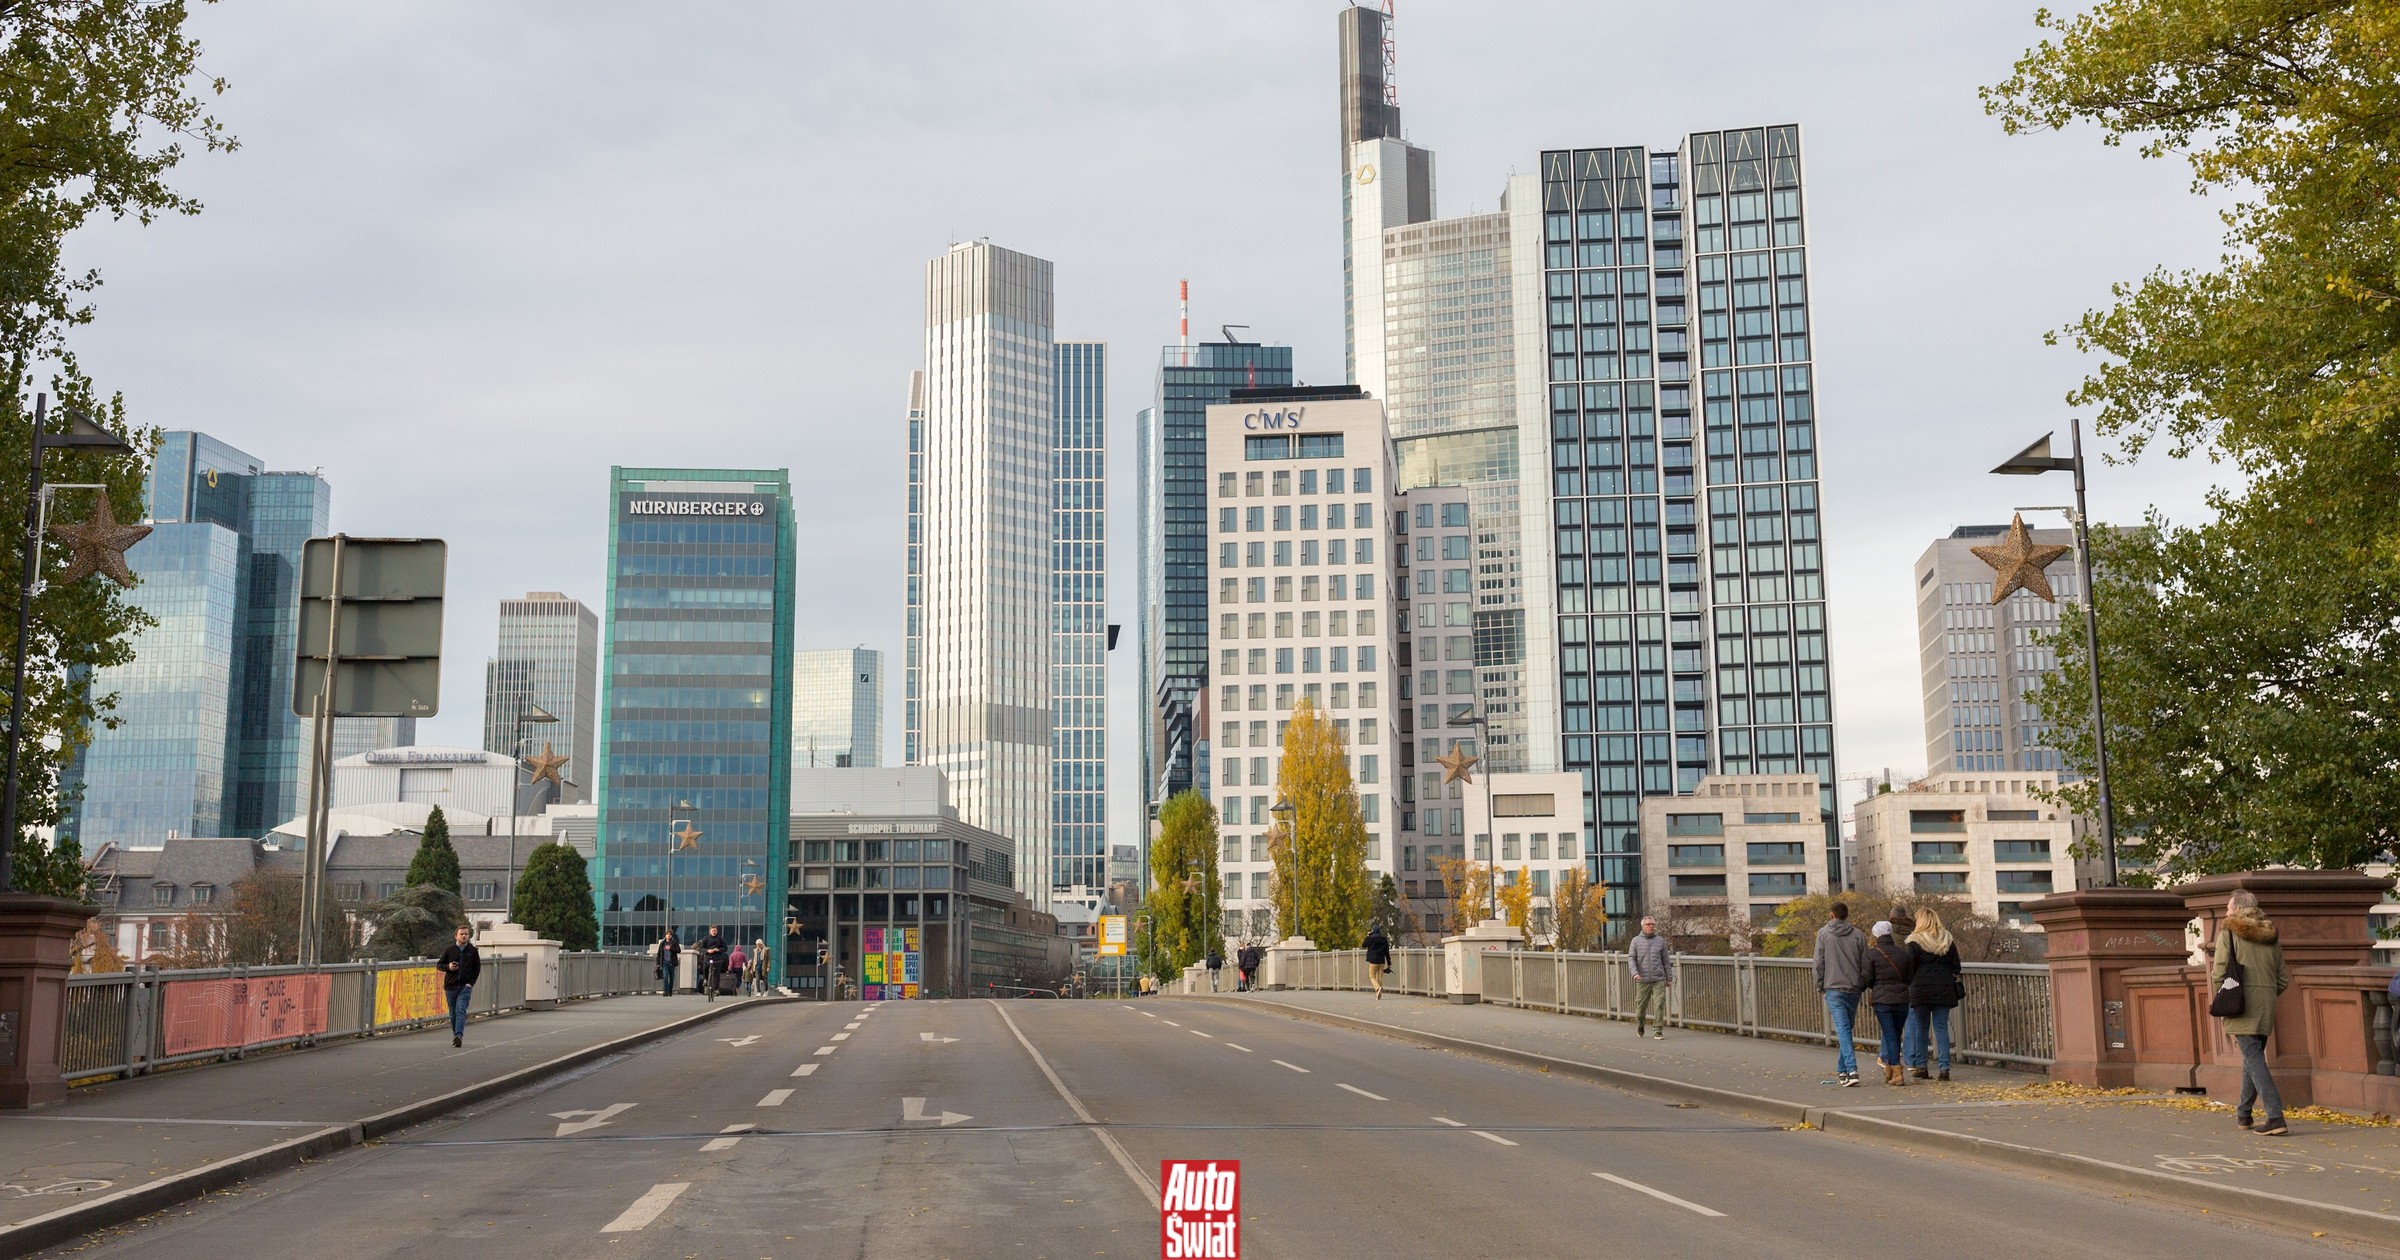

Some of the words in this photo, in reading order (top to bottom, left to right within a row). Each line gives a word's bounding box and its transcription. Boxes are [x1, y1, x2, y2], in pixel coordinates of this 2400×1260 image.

[630, 500, 747, 515] NÜRNBERGER
[848, 823, 893, 834] SCHAUSPIEL
[265, 980, 285, 997] HOUSE
[260, 1000, 269, 1017] OF
[271, 1017, 285, 1034] WAY
